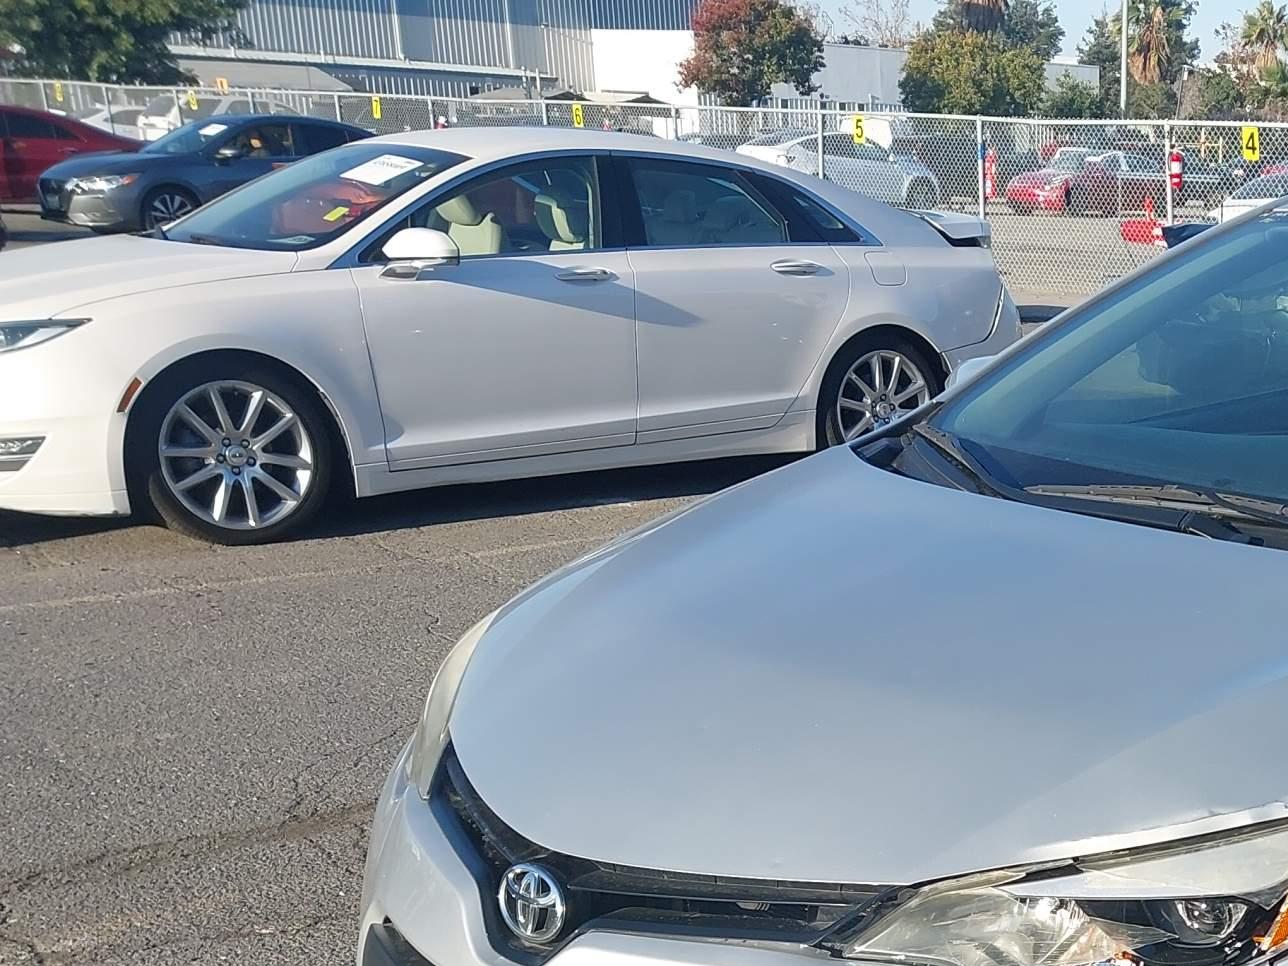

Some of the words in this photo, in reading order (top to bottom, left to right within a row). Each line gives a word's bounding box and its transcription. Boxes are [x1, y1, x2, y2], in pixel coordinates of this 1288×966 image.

[575, 107, 581, 125] 6
[855, 118, 864, 139] 5
[1245, 131, 1257, 155] 4
